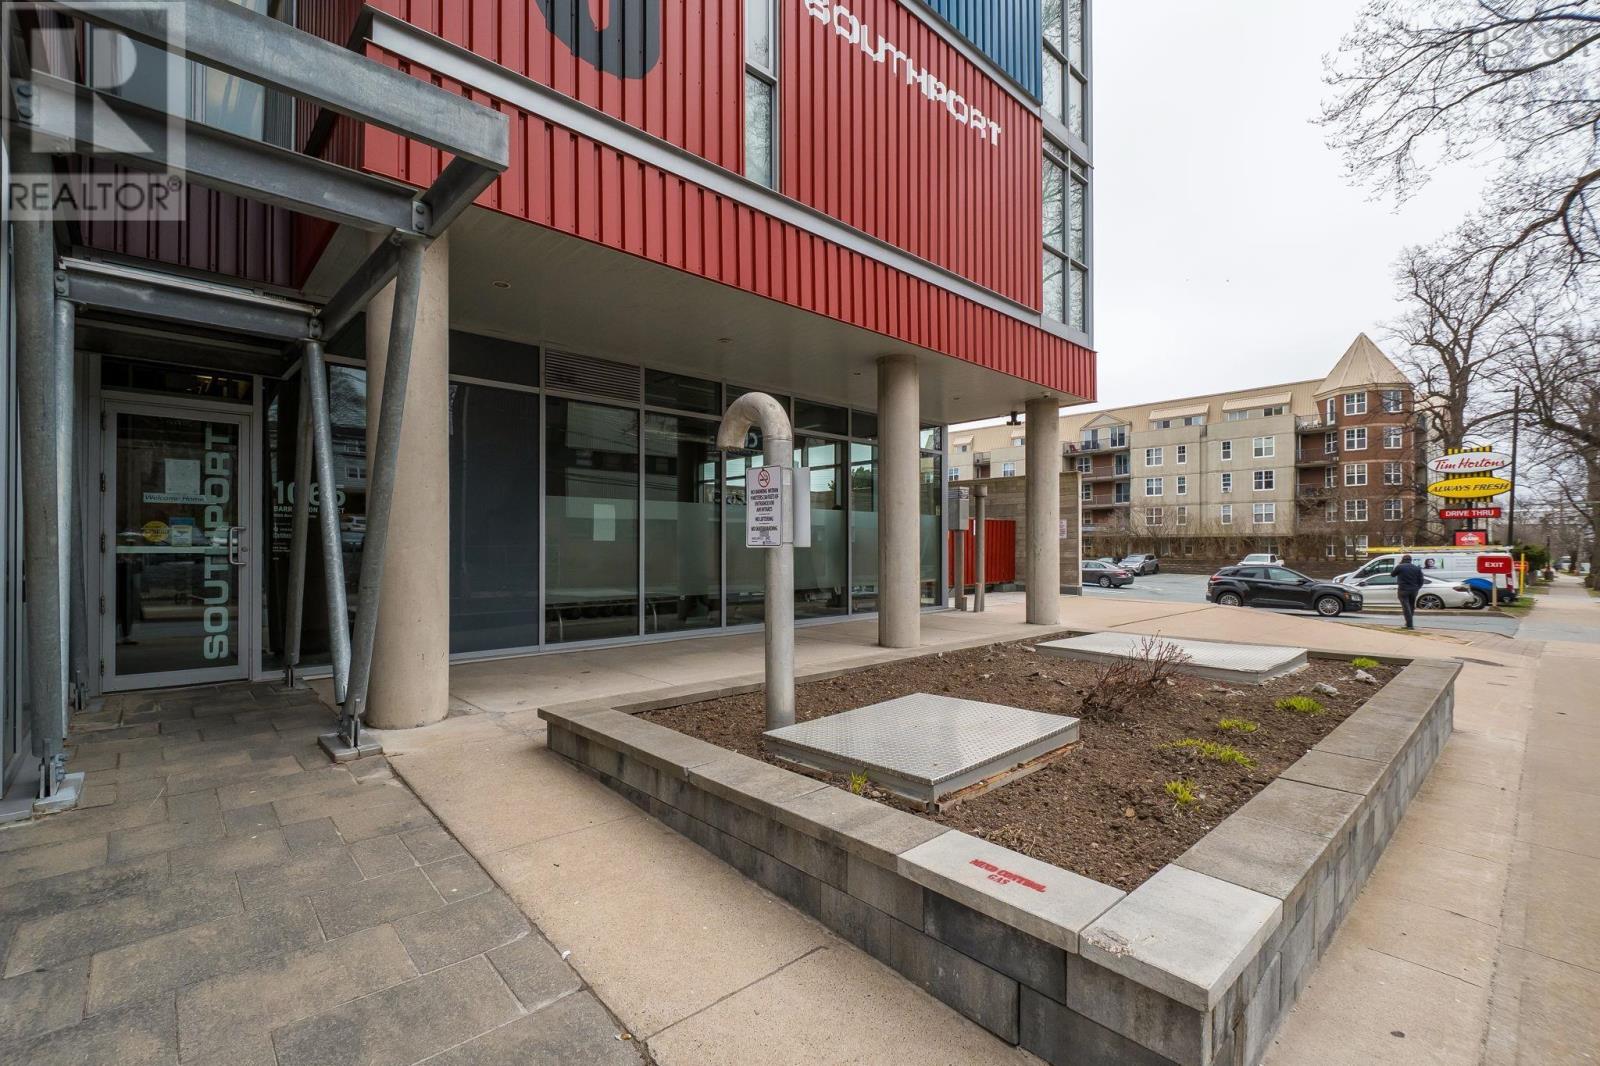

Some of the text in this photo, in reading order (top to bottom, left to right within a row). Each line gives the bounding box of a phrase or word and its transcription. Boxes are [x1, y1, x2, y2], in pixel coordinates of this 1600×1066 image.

[804, 0, 1001, 146] SOUTHPORT
[1434, 457, 1505, 470] Tim Hortons
[1432, 483, 1510, 493] ALWAYS FRESH
[273, 505, 318, 513] BARRON
[204, 425, 231, 660] SOUTHPORT
[987, 874, 1011, 885] GAS
